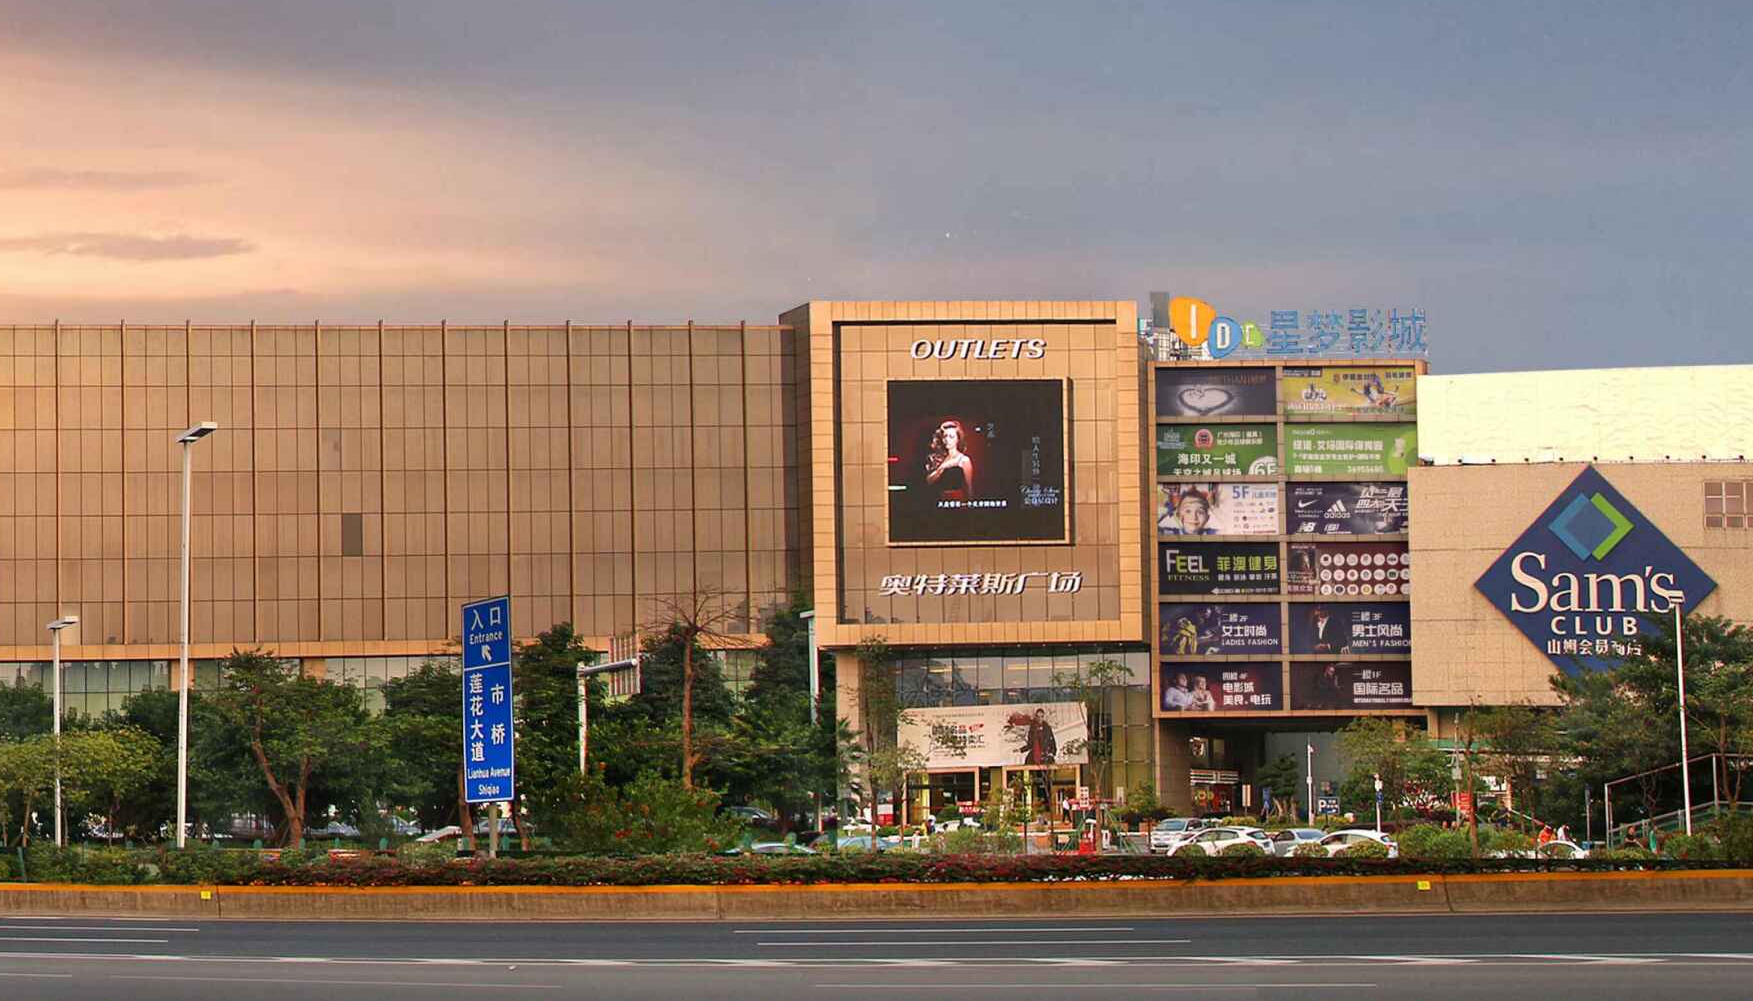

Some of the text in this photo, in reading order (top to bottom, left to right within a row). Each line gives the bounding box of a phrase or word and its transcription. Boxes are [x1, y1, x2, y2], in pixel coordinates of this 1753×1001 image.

[1266, 307, 1429, 355] 星梦影城
[909, 338, 1047, 361] OUTLETS
[1177, 452, 1237, 465] 海印又一城
[1232, 485, 1250, 500] 5F
[1166, 549, 1210, 573] FEEL
[878, 571, 1083, 598] 奥特莱斯广场
[1510, 551, 1675, 614] Sam's
[470, 605, 501, 631] 入口
[1550, 616, 1638, 636] CLUB
[469, 630, 504, 646] Entrance
[1221, 624, 1267, 638] 女士时尚
[1351, 623, 1403, 638] 男士风尚
[1221, 637, 1279, 646] LADIES FASHION
[1222, 681, 1255, 694] 电影城
[1352, 682, 1404, 696] 国际名品
[470, 673, 486, 762] 莲花大道
[490, 683, 506, 746] 市桥
